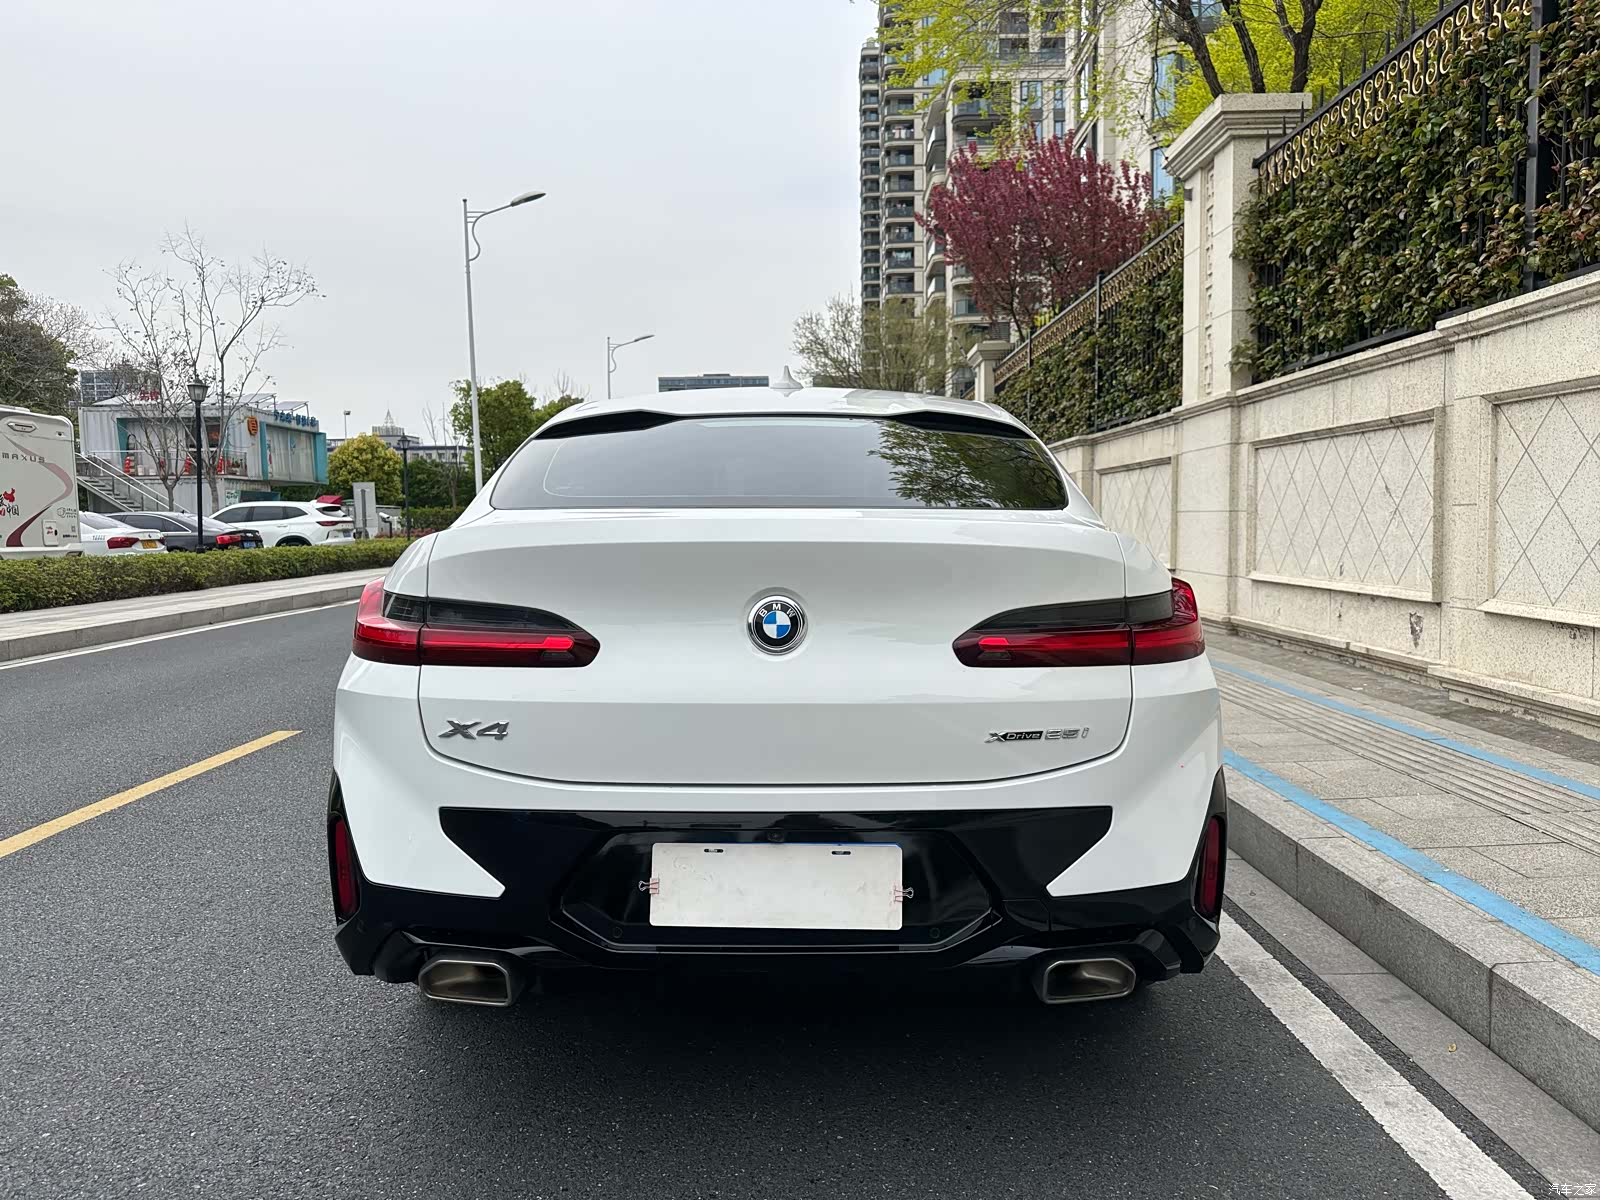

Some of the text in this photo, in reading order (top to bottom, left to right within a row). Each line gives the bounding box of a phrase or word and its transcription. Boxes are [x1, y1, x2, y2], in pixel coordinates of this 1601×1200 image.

[2, 452, 45, 463] MAXUS
[759, 603, 796, 617] BMW
[438, 720, 510, 740] X4
